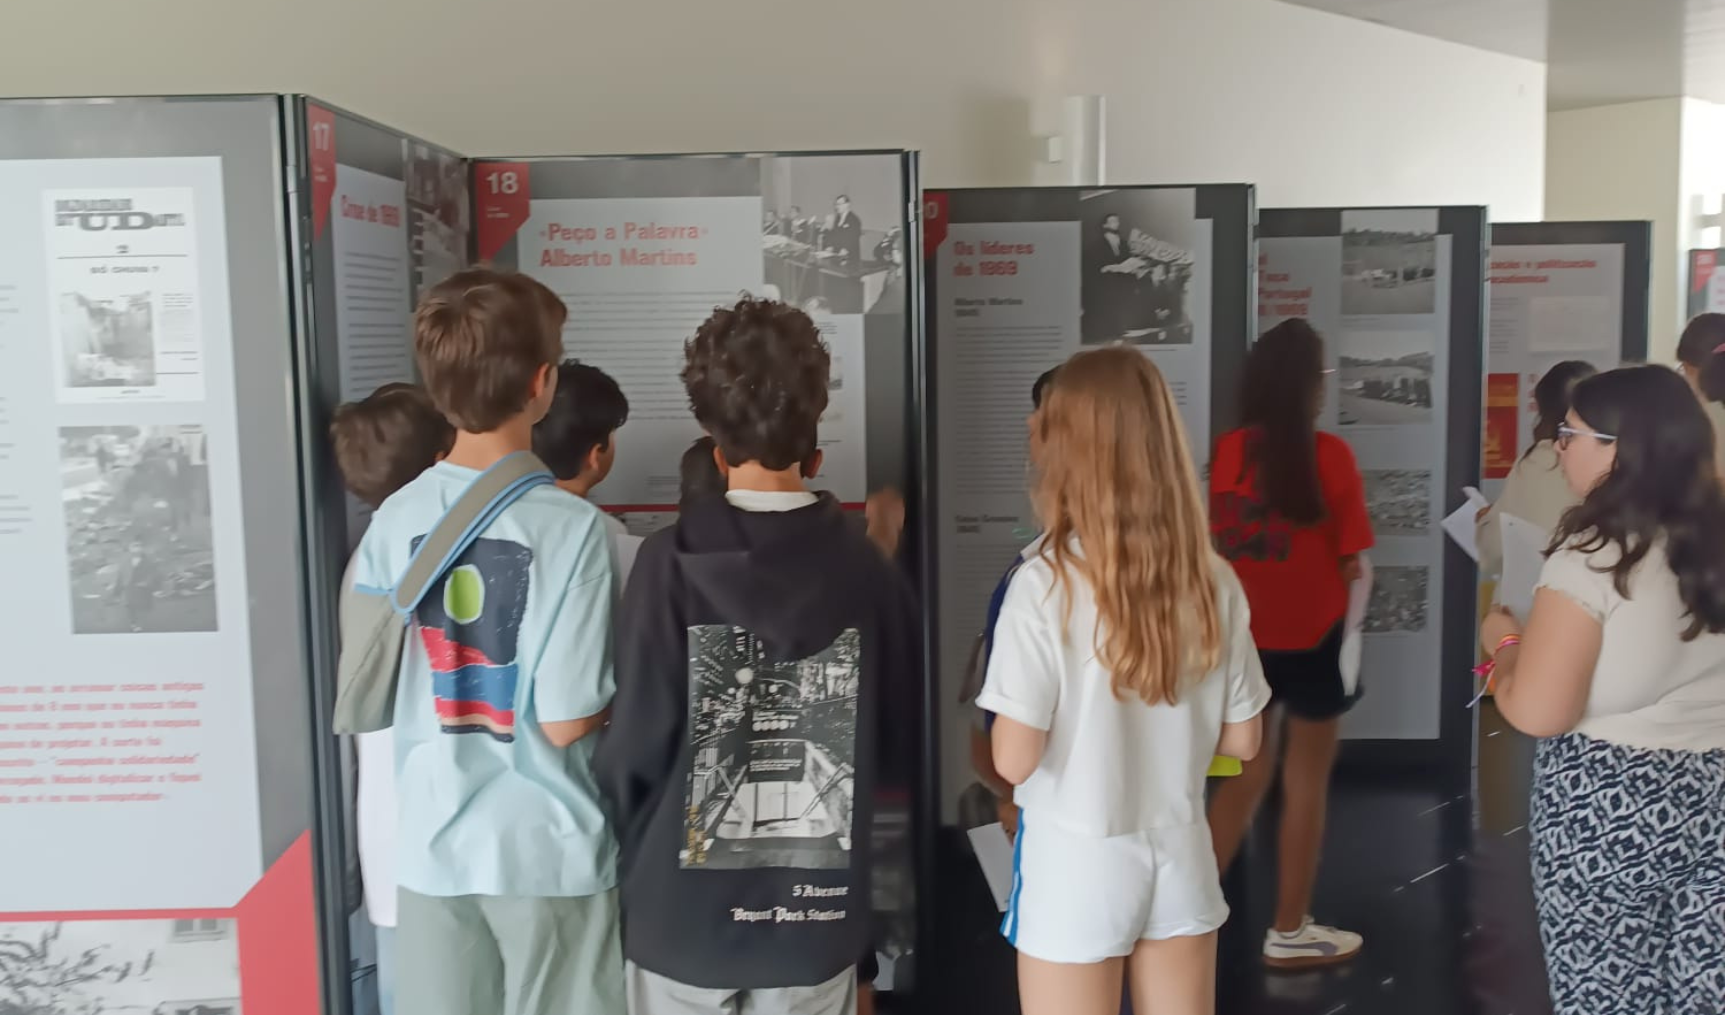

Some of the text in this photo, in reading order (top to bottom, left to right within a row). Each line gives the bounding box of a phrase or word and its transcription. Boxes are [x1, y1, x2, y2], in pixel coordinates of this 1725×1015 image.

[313, 121, 330, 150] 17
[486, 171, 519, 195] 18
[604, 228, 617, 241] a
[954, 240, 1035, 256] Os líderes
[540, 248, 698, 268] Alberto Martins
[953, 261, 974, 276] de
[773, 905, 805, 923] Park
[806, 908, 847, 921] Station
